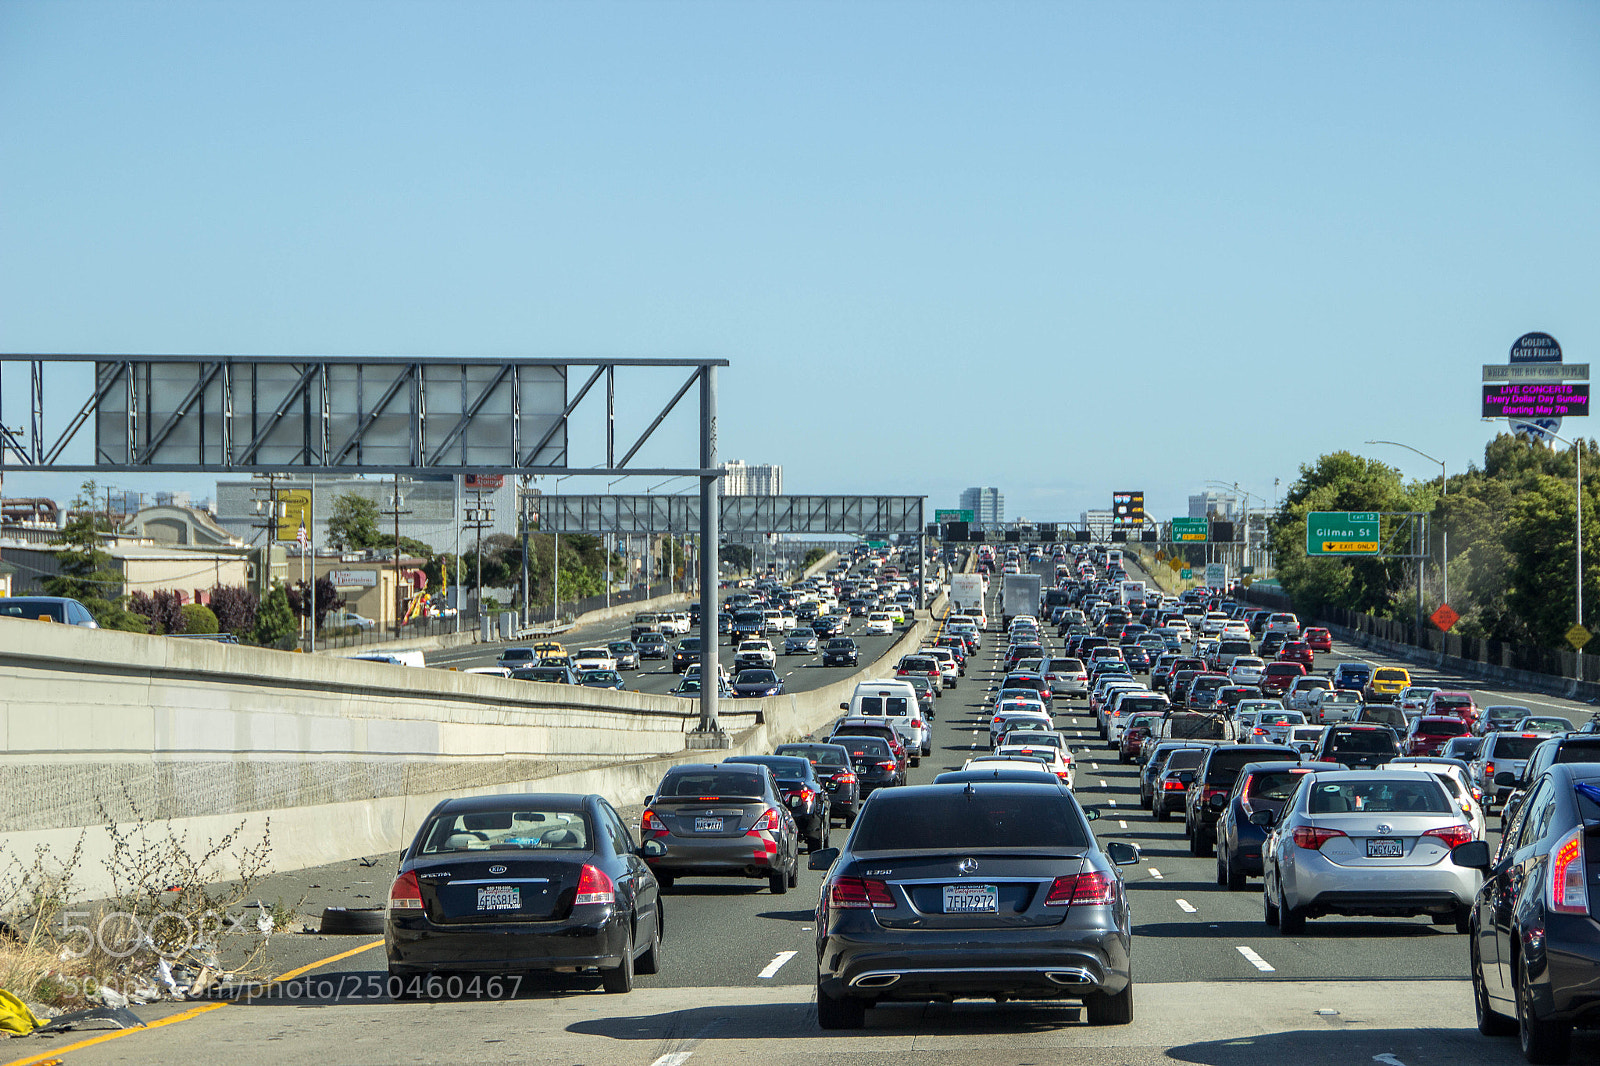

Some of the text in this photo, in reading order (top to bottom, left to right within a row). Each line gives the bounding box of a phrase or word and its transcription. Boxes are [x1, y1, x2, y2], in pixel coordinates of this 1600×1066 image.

[1521, 338, 1552, 347] GOLDEN
[1513, 348, 1560, 357] GATE FIELDS
[1487, 367, 1585, 377] WHERE THE BAY COMES TO PLAY
[1501, 386, 1573, 394] LIVE CONCERTS
[1486, 395, 1587, 405] Every Dollar Day Sunday
[1502, 406, 1534, 415] Starting
[1536, 406, 1553, 415] May
[1359, 528, 1371, 536] St
[479, 894, 519, 906] 6FGS815
